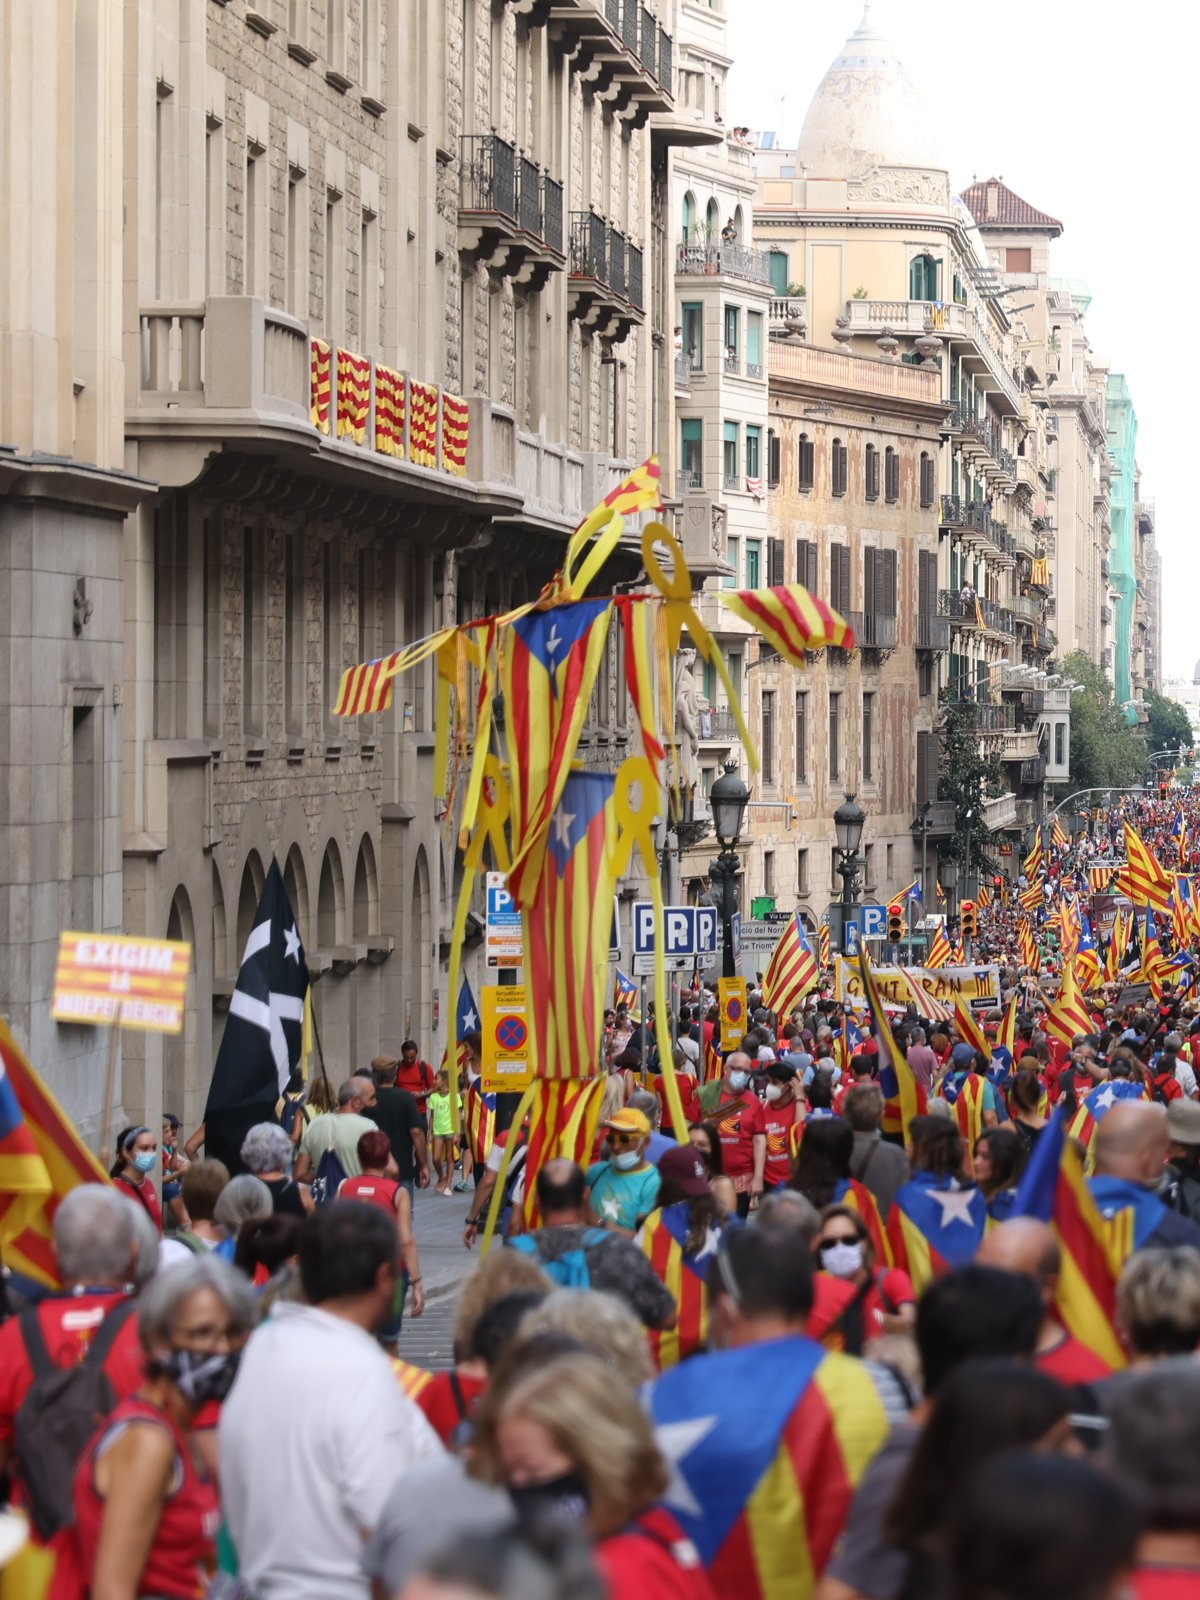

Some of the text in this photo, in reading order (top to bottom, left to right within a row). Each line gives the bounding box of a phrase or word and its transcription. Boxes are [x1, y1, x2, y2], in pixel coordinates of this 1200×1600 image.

[495, 890, 511, 912] P
[641, 909, 655, 948] P
[768, 925, 785, 933] Nord
[865, 908, 882, 934] P
[76, 940, 173, 974] EXIGIM
[110, 970, 131, 993] LA
[847, 975, 961, 998] GNT RAN
[56, 993, 179, 1024] INDEPEDÈNCIA
